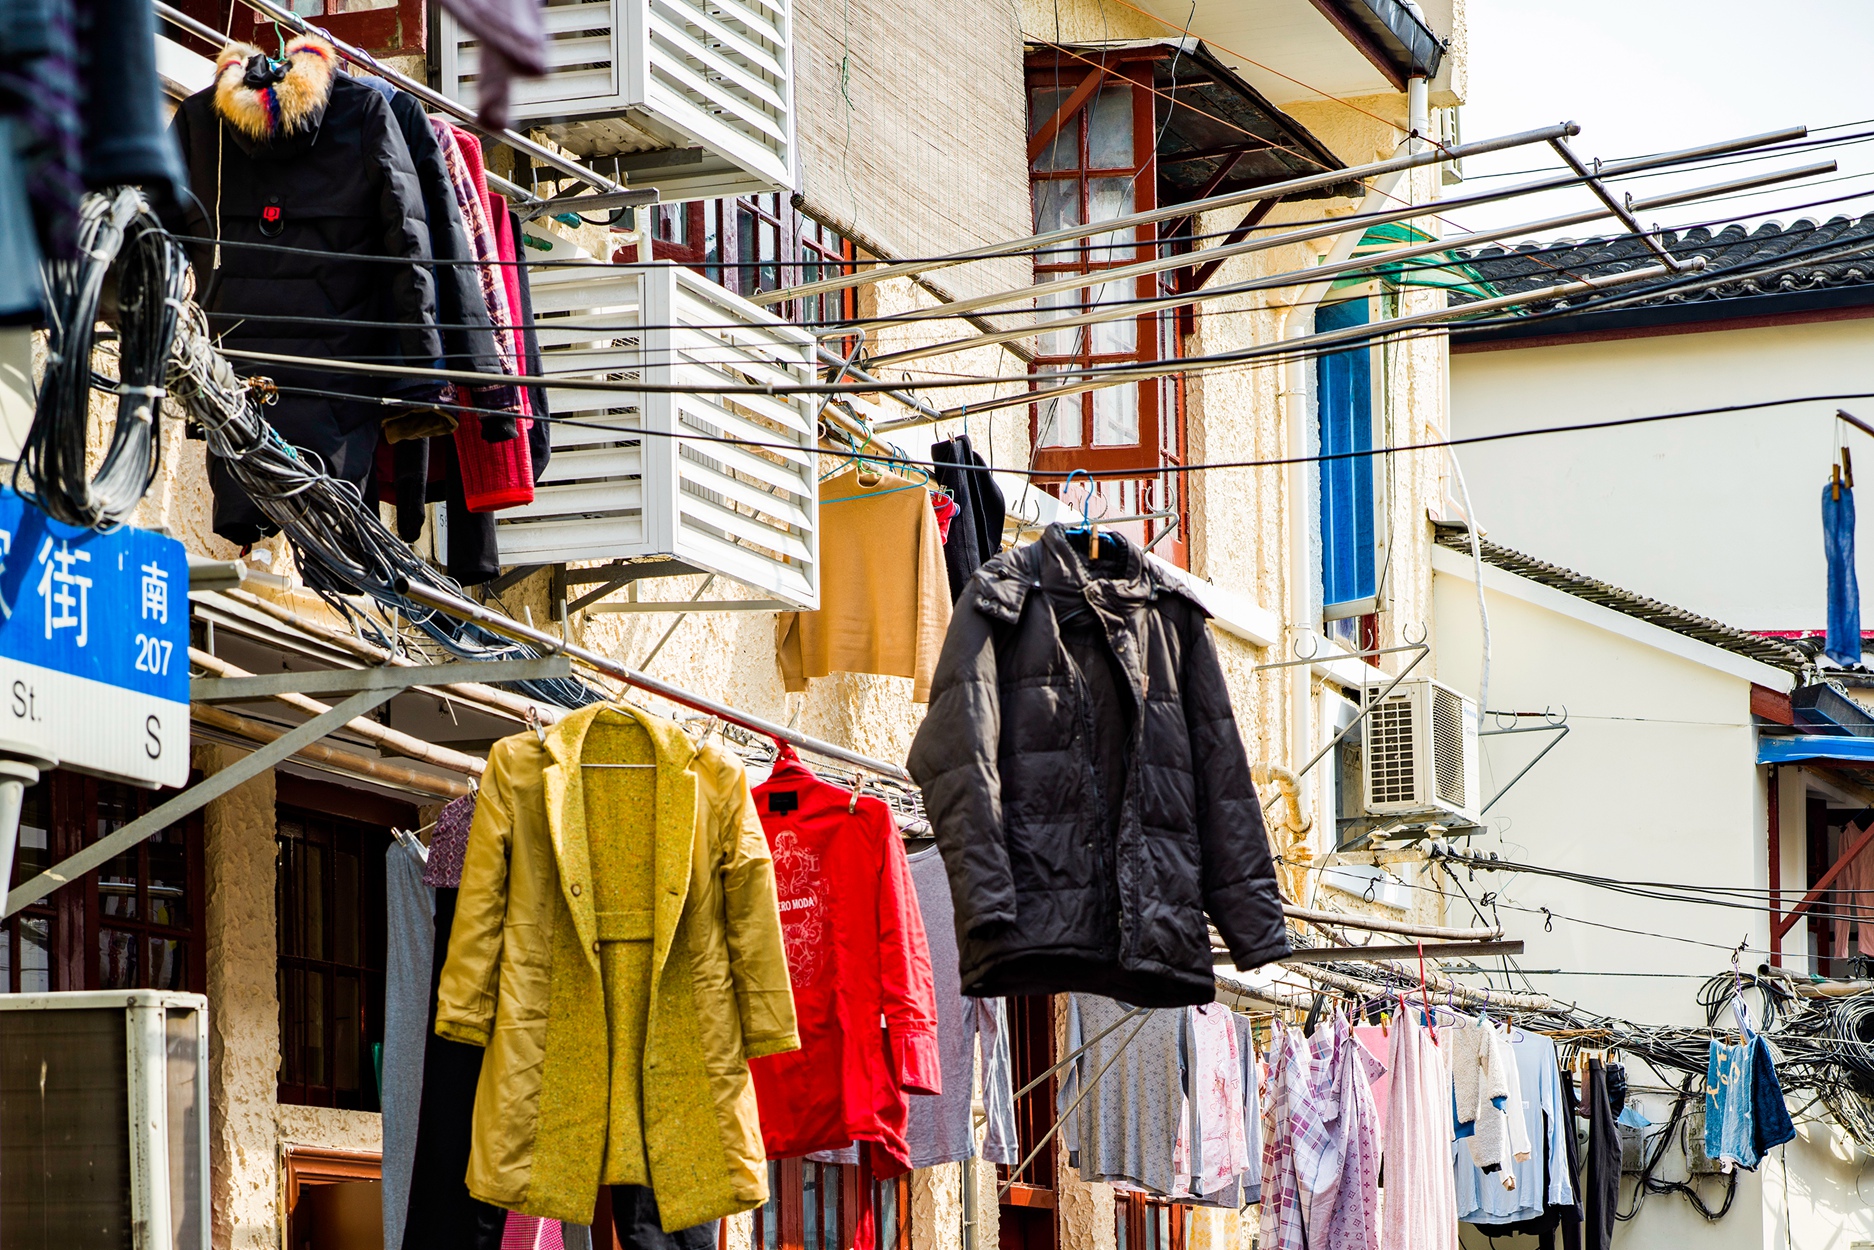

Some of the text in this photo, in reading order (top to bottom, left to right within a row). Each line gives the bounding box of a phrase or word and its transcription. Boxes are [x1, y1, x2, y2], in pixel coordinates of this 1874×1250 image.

[141, 560, 168, 625] 南
[134, 633, 173, 676] 207
[11, 680, 42, 722] St.
[145, 714, 162, 760] S
[778, 896, 815, 912] ERO MODA
